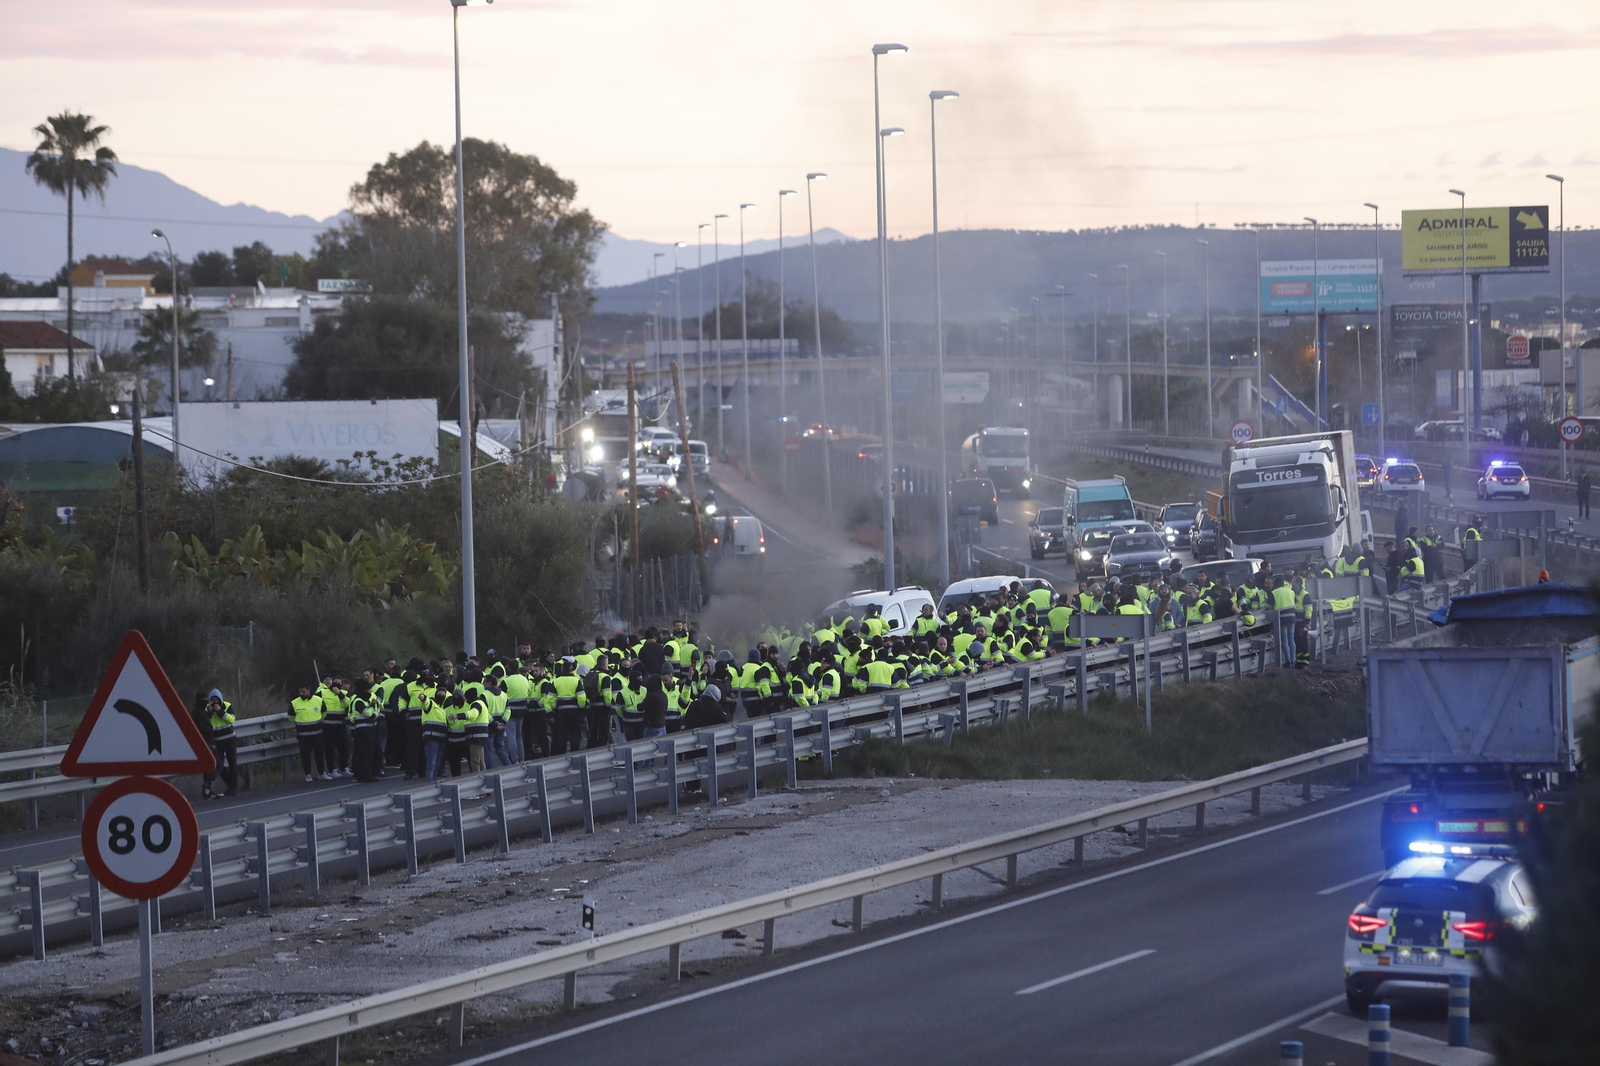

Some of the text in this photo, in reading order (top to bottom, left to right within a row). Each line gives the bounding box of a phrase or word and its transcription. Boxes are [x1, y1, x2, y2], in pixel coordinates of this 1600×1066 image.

[1417, 216, 1499, 231] ADMIRAL
[1516, 239, 1545, 247] SALIDA
[1395, 311, 1433, 321] TOYOTA
[285, 418, 397, 447] VIVEROS
[1233, 428, 1251, 438] 100
[1562, 425, 1581, 435] 100
[1256, 469, 1302, 482] Torres
[108, 814, 172, 855] 80
